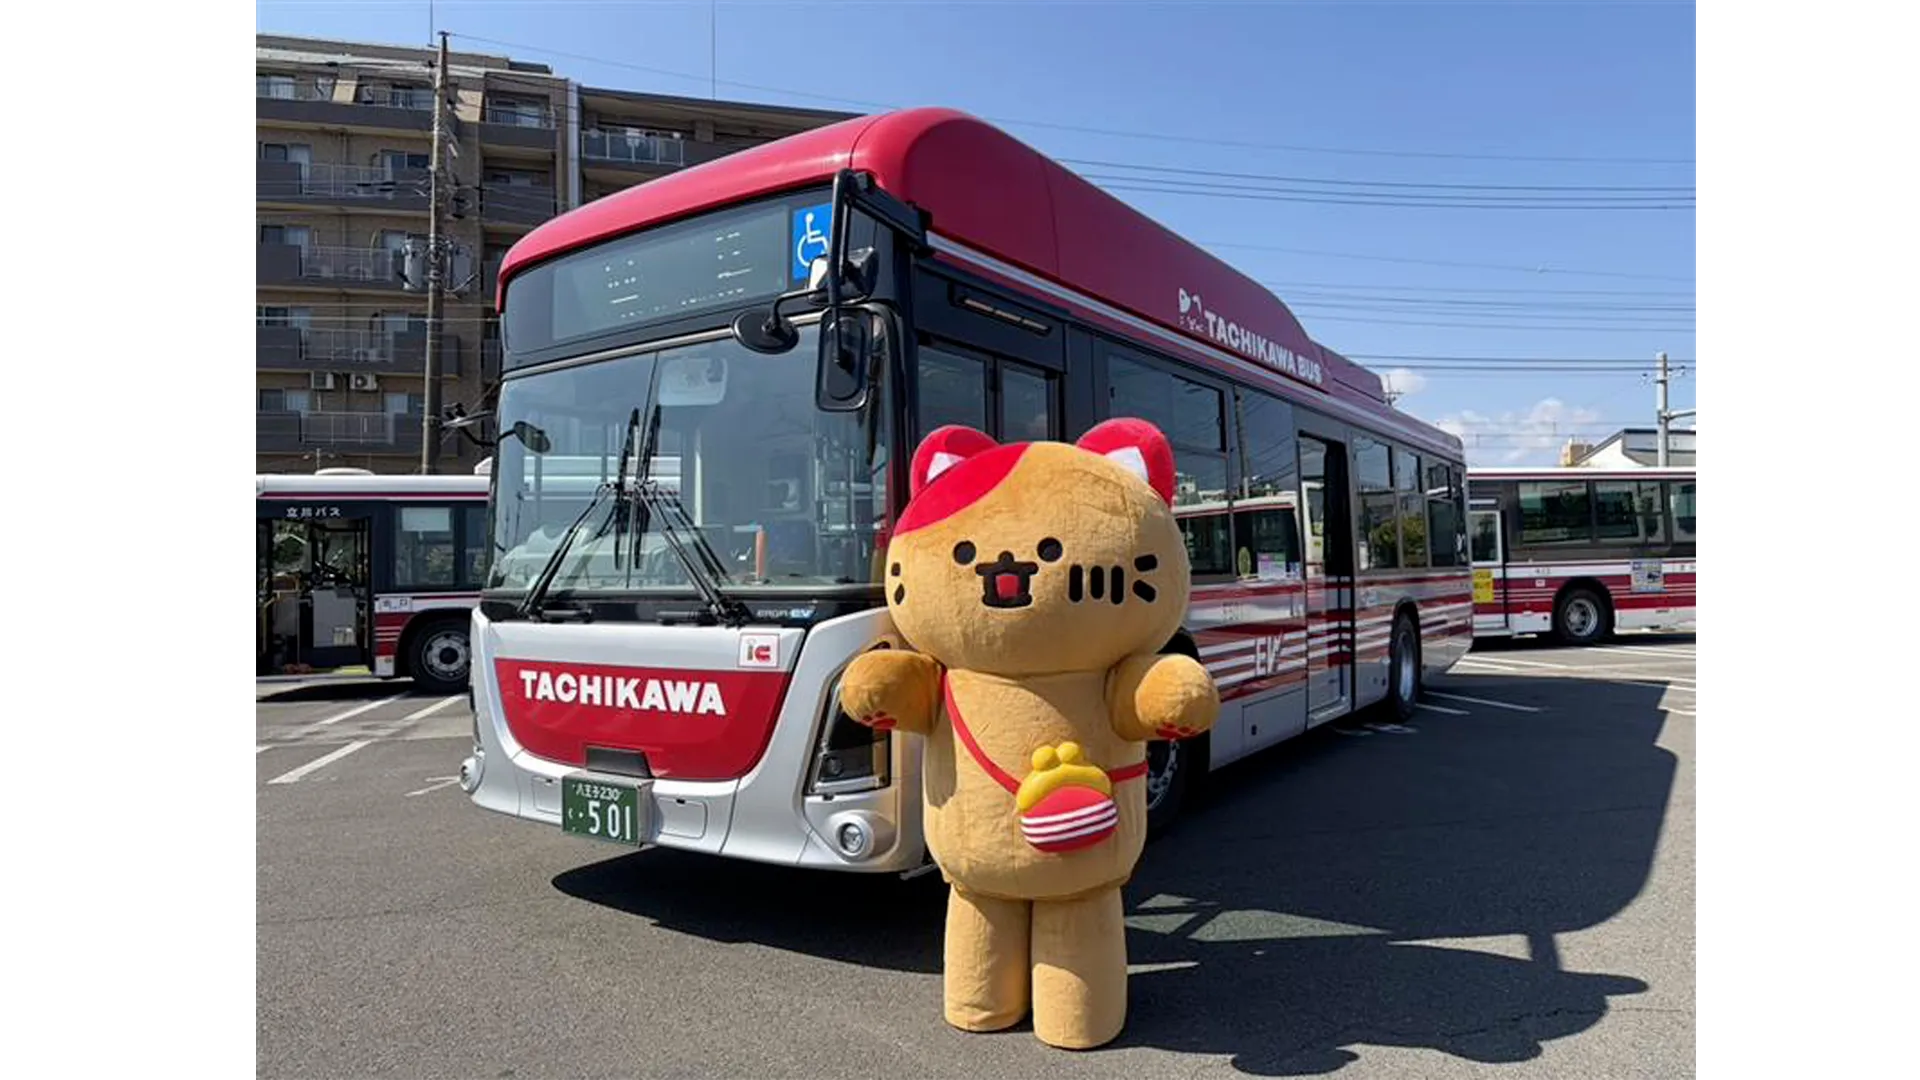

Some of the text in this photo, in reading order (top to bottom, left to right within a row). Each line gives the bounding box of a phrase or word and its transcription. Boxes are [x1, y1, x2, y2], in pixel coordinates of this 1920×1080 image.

[1204, 309, 1323, 385] TACHIKAWA BUS
[286, 506, 341, 518] 立川バス
[1255, 631, 1283, 676] EV
[519, 669, 726, 716] TACHIKAWA
